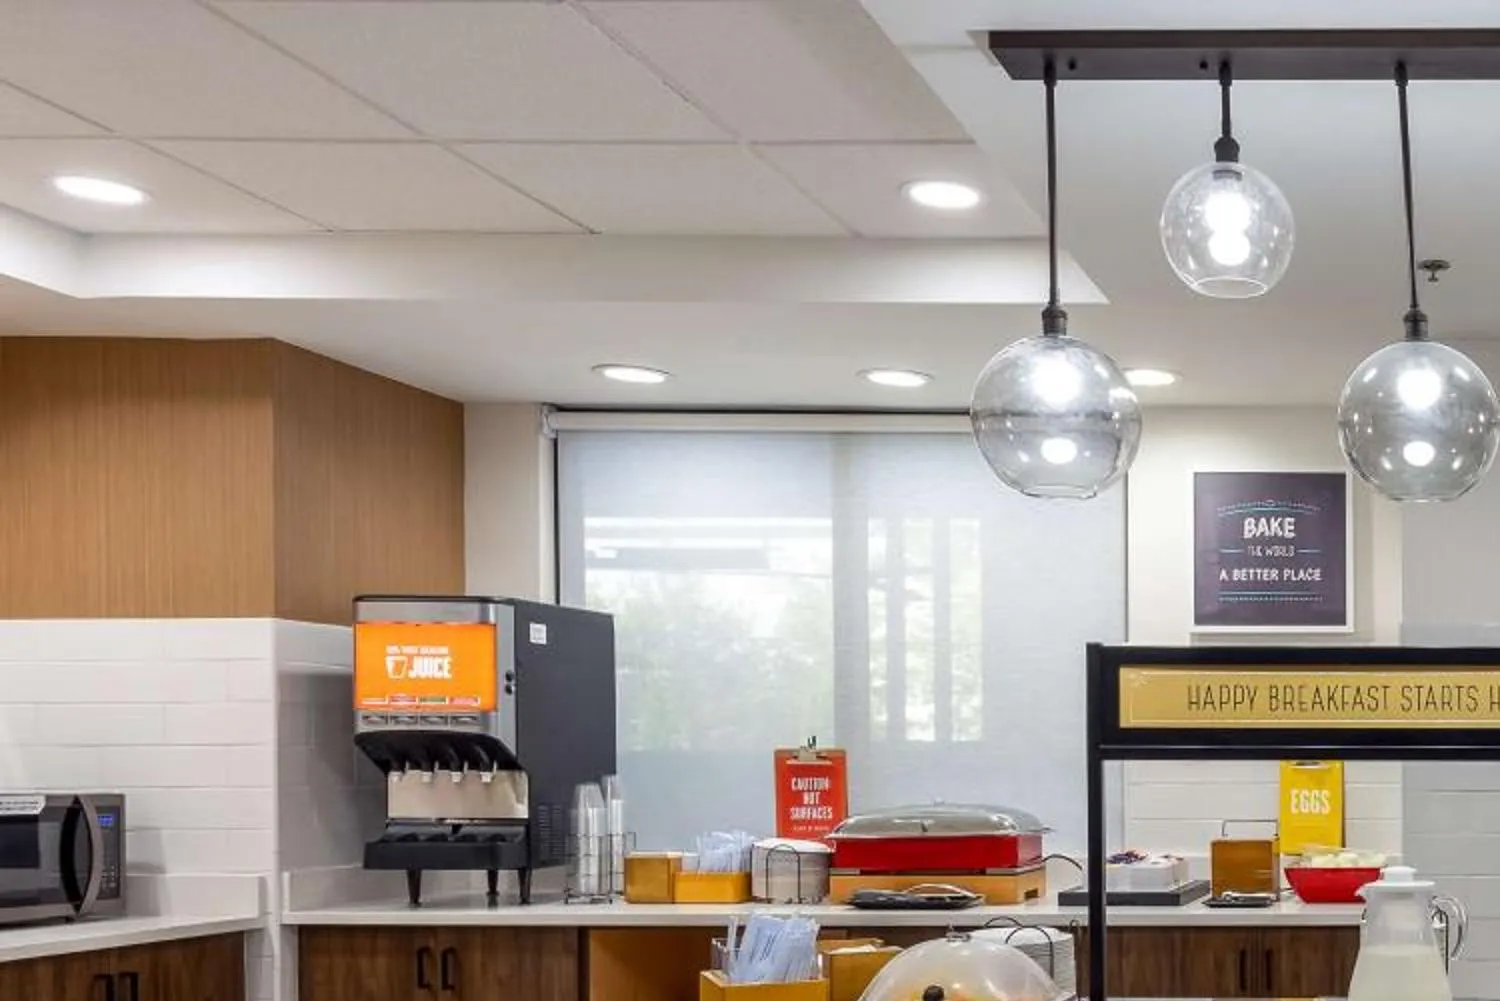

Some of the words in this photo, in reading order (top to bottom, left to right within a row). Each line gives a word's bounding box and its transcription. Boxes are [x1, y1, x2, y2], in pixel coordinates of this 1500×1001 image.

[1243, 517, 1296, 539] BAKE
[1219, 568, 1229, 581] A
[1232, 568, 1279, 581] BETTER
[1283, 568, 1323, 581] PLACE
[408, 655, 452, 679] JUICE
[1187, 684, 1258, 712] HAPPY
[1268, 684, 1391, 712] BREAKFAST
[1400, 684, 1479, 712] STARTS
[1291, 788, 1331, 815] EGGS
